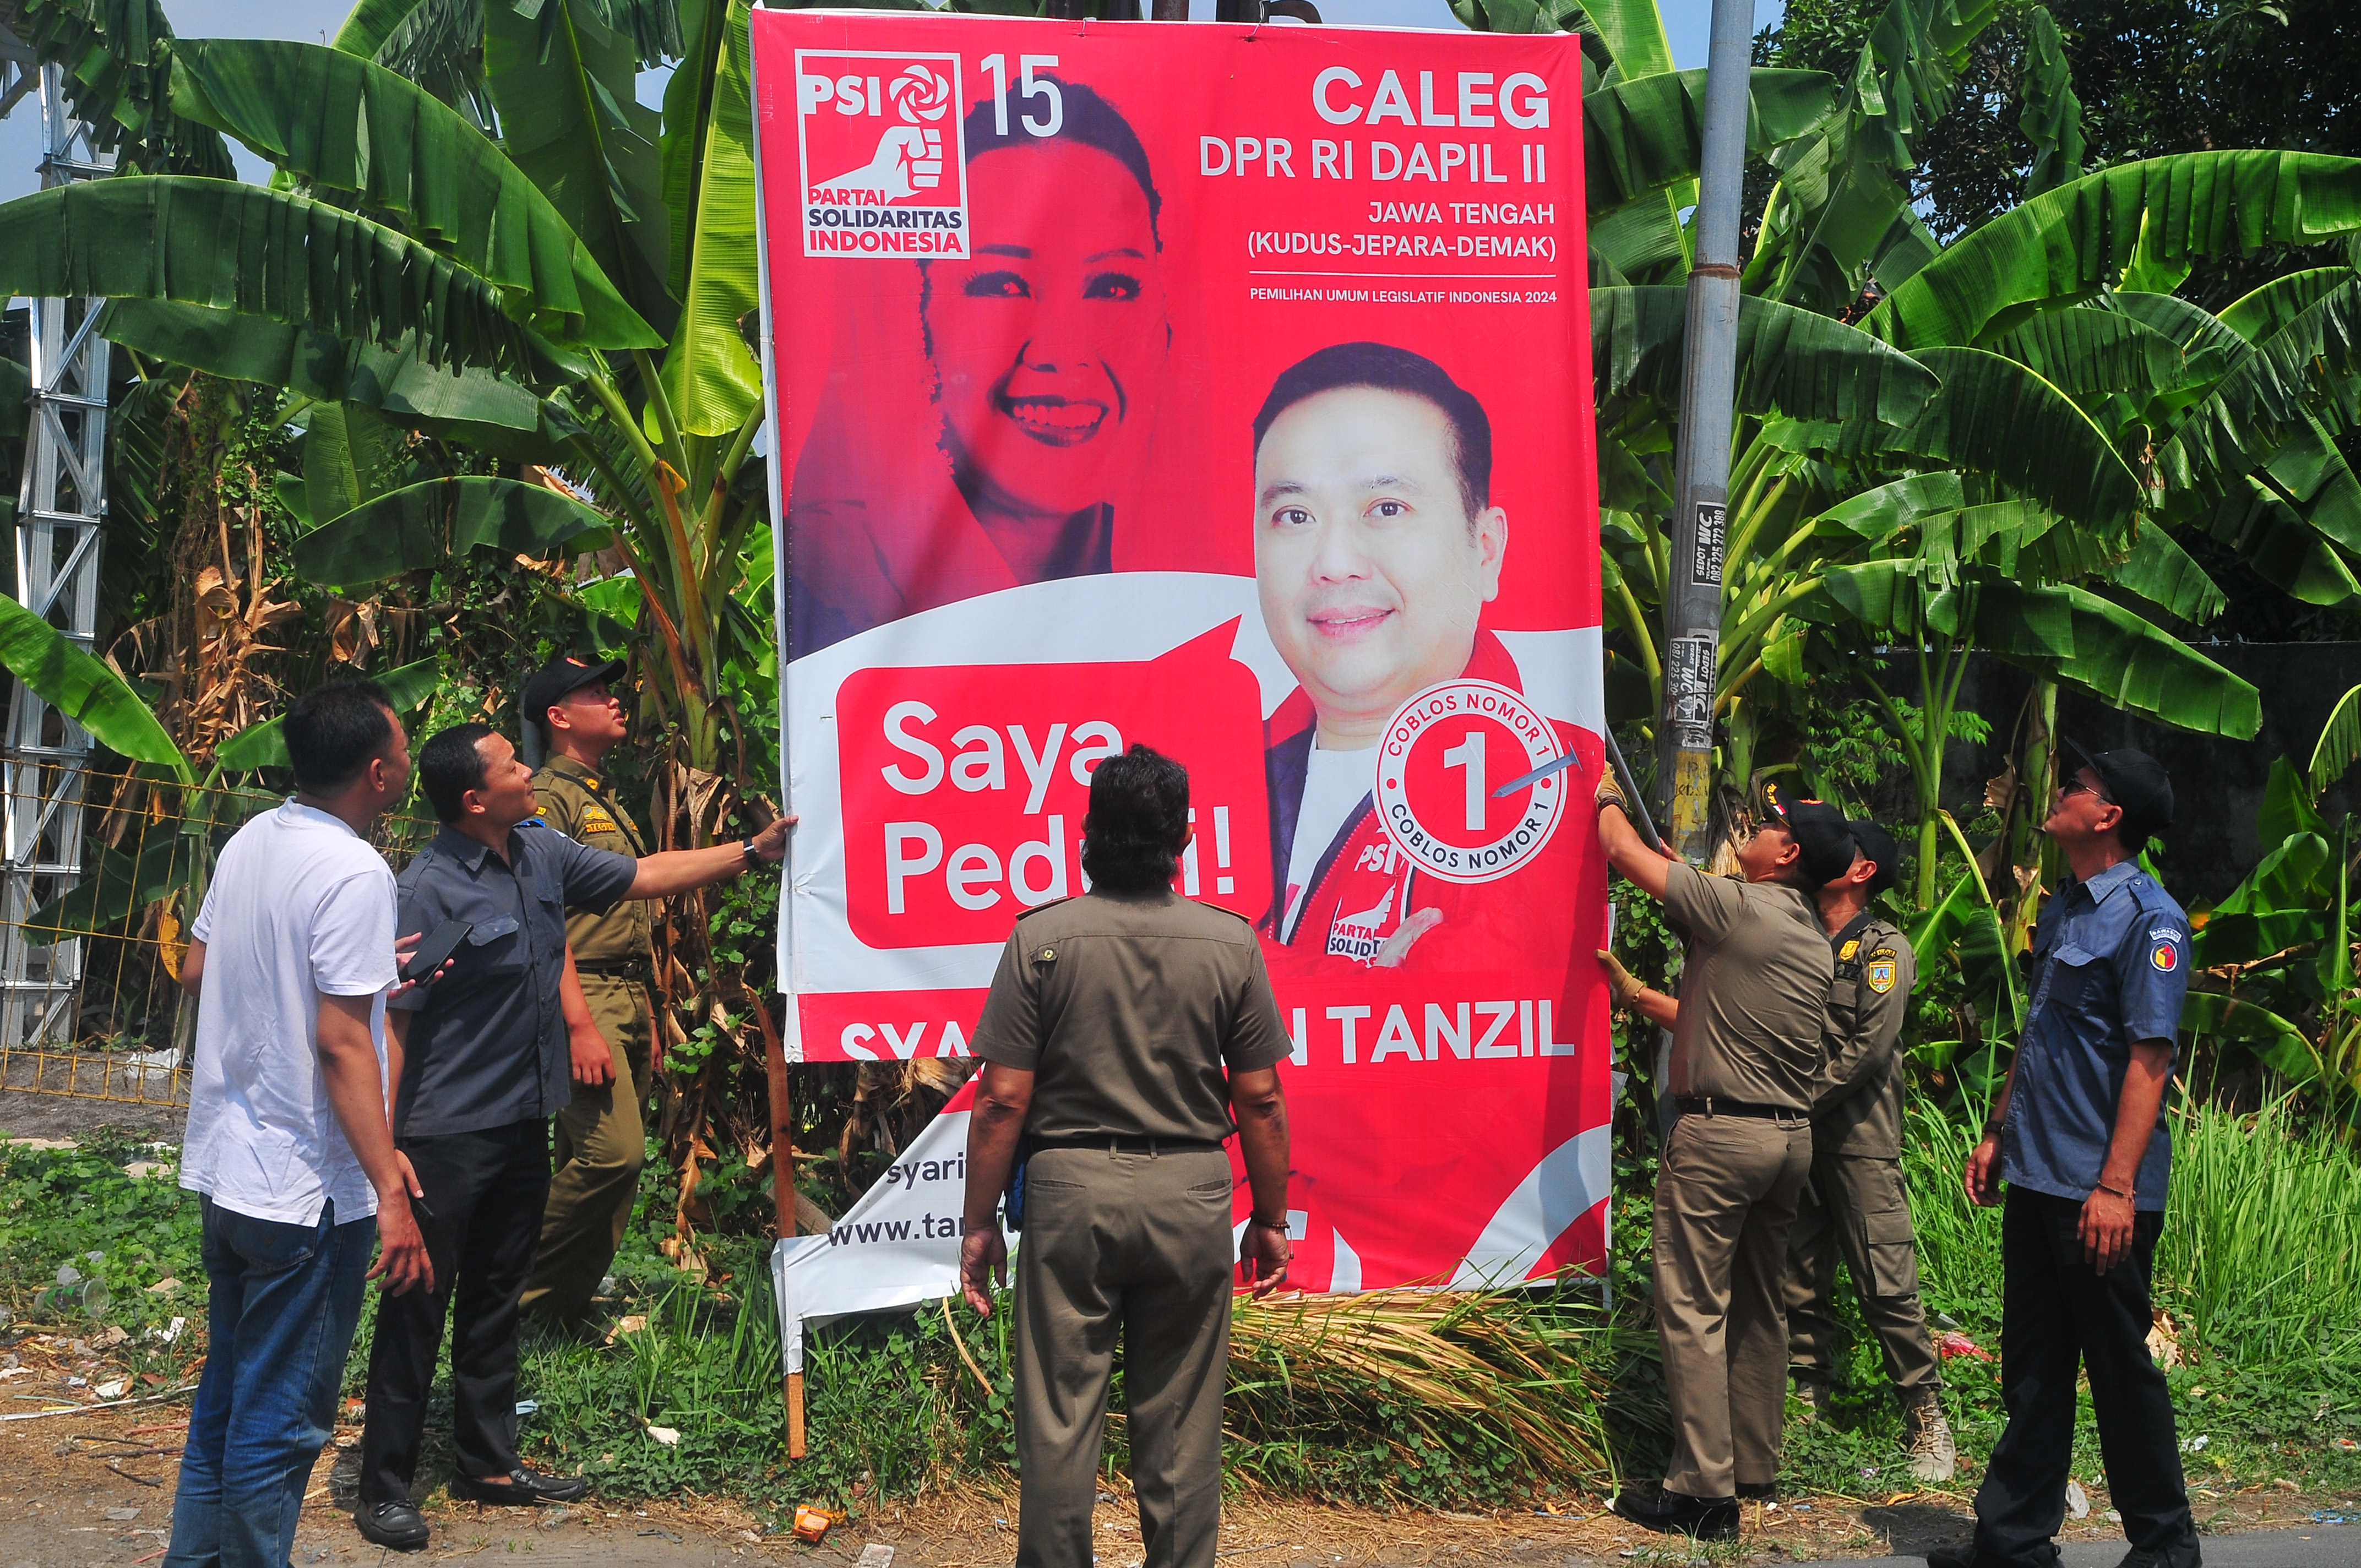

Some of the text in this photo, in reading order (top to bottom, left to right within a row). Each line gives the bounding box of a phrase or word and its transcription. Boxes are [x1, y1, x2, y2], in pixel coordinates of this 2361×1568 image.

[802, 74, 881, 117] PSI
[980, 53, 1064, 137] 15
[1312, 66, 1550, 129] CALEG
[1199, 135, 1546, 183] DPR RI DAPIL II
[809, 188, 885, 206] PARTAI
[1368, 202, 1554, 224] JAWA TENGAH
[809, 209, 962, 229] SOLIDARITAS
[809, 230, 963, 253] INDONESIA
[1248, 231, 1557, 263] (KUDUS-JEPARA-DEMAK)
[1250, 287, 1558, 304] PEMILIHAN UMUM LEGISLATIF INDONESIA 2024
[1696, 512, 1712, 576] SEDOT WC
[1710, 509, 1725, 581] 082 225 272 388
[1672, 643, 1681, 658] 081
[1702, 649, 1710, 679] SEDOT
[1671, 660, 1680, 679] 225
[1680, 667, 1695, 693] WC
[1388, 693, 1551, 758] COBLOS NOMOR 1
[1443, 731, 1486, 830] 1
[1391, 802, 1549, 870] COBLOS NOMOR 1
[1353, 843, 1397, 875] PSI
[1326, 999, 1575, 1064] TANZIL
[886, 1152, 967, 1190] syari
